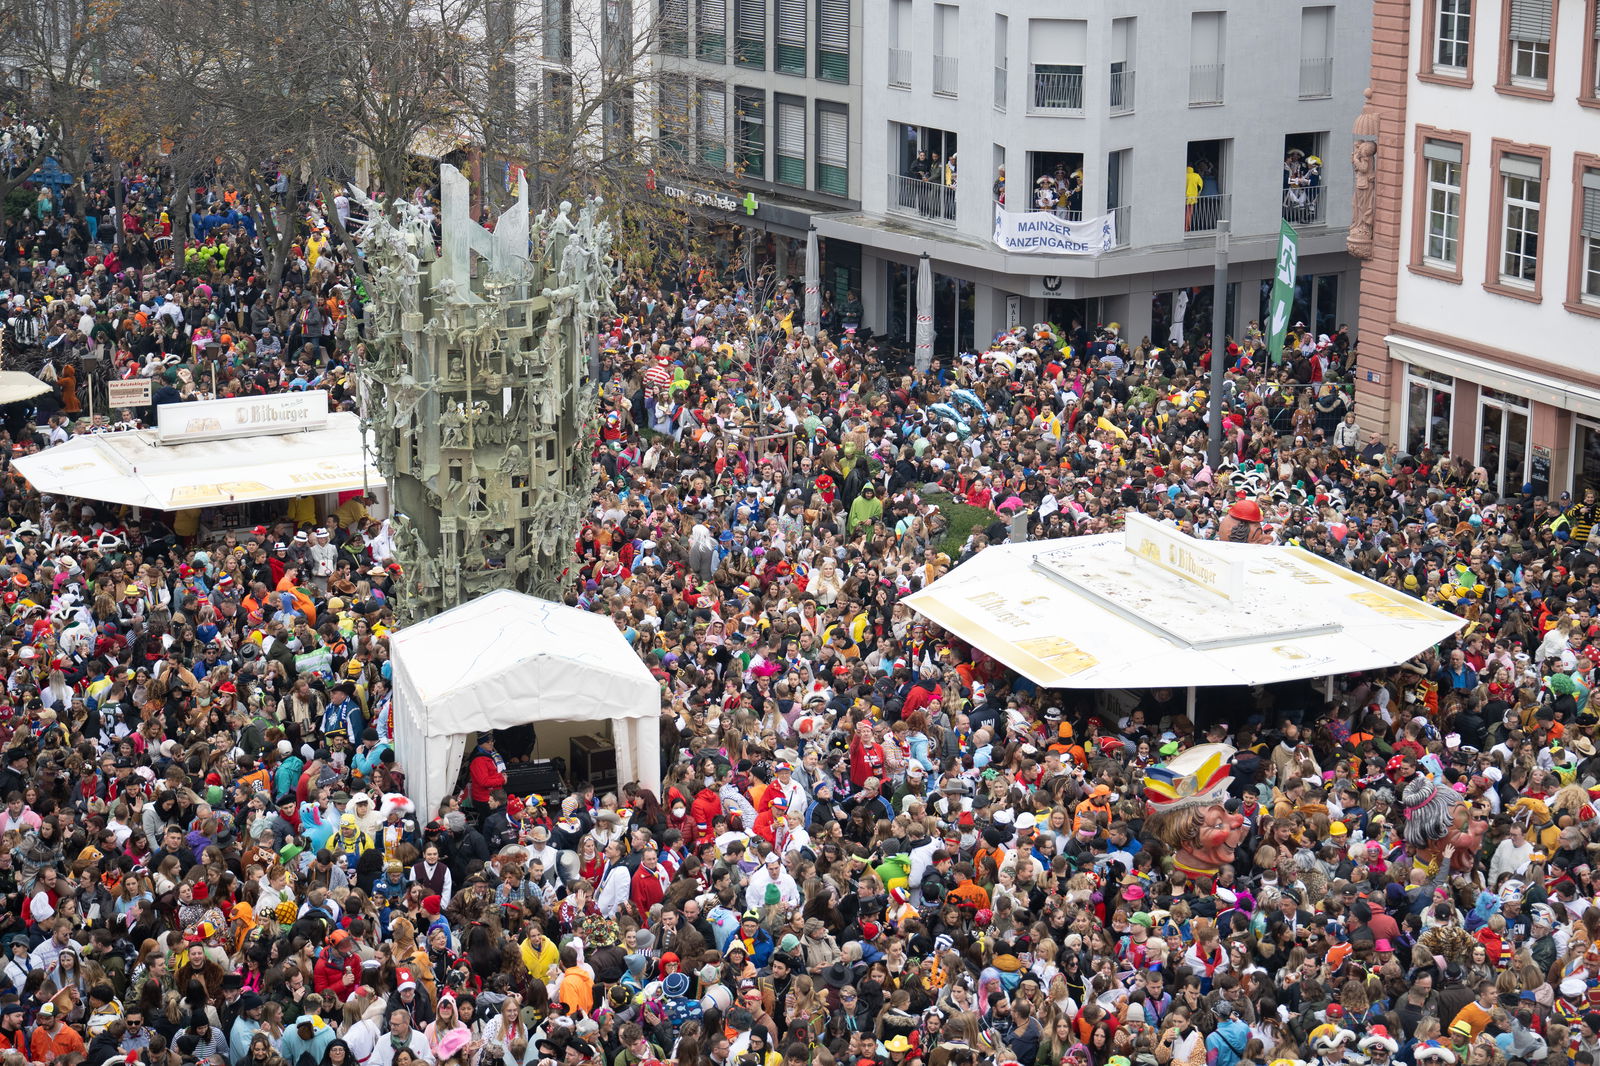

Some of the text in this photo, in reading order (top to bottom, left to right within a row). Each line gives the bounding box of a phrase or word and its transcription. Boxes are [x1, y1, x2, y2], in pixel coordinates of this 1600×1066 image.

[1018, 221, 1071, 236] MAINZER
[250, 404, 308, 423] Bitburger
[1178, 547, 1217, 584] Bitburger
